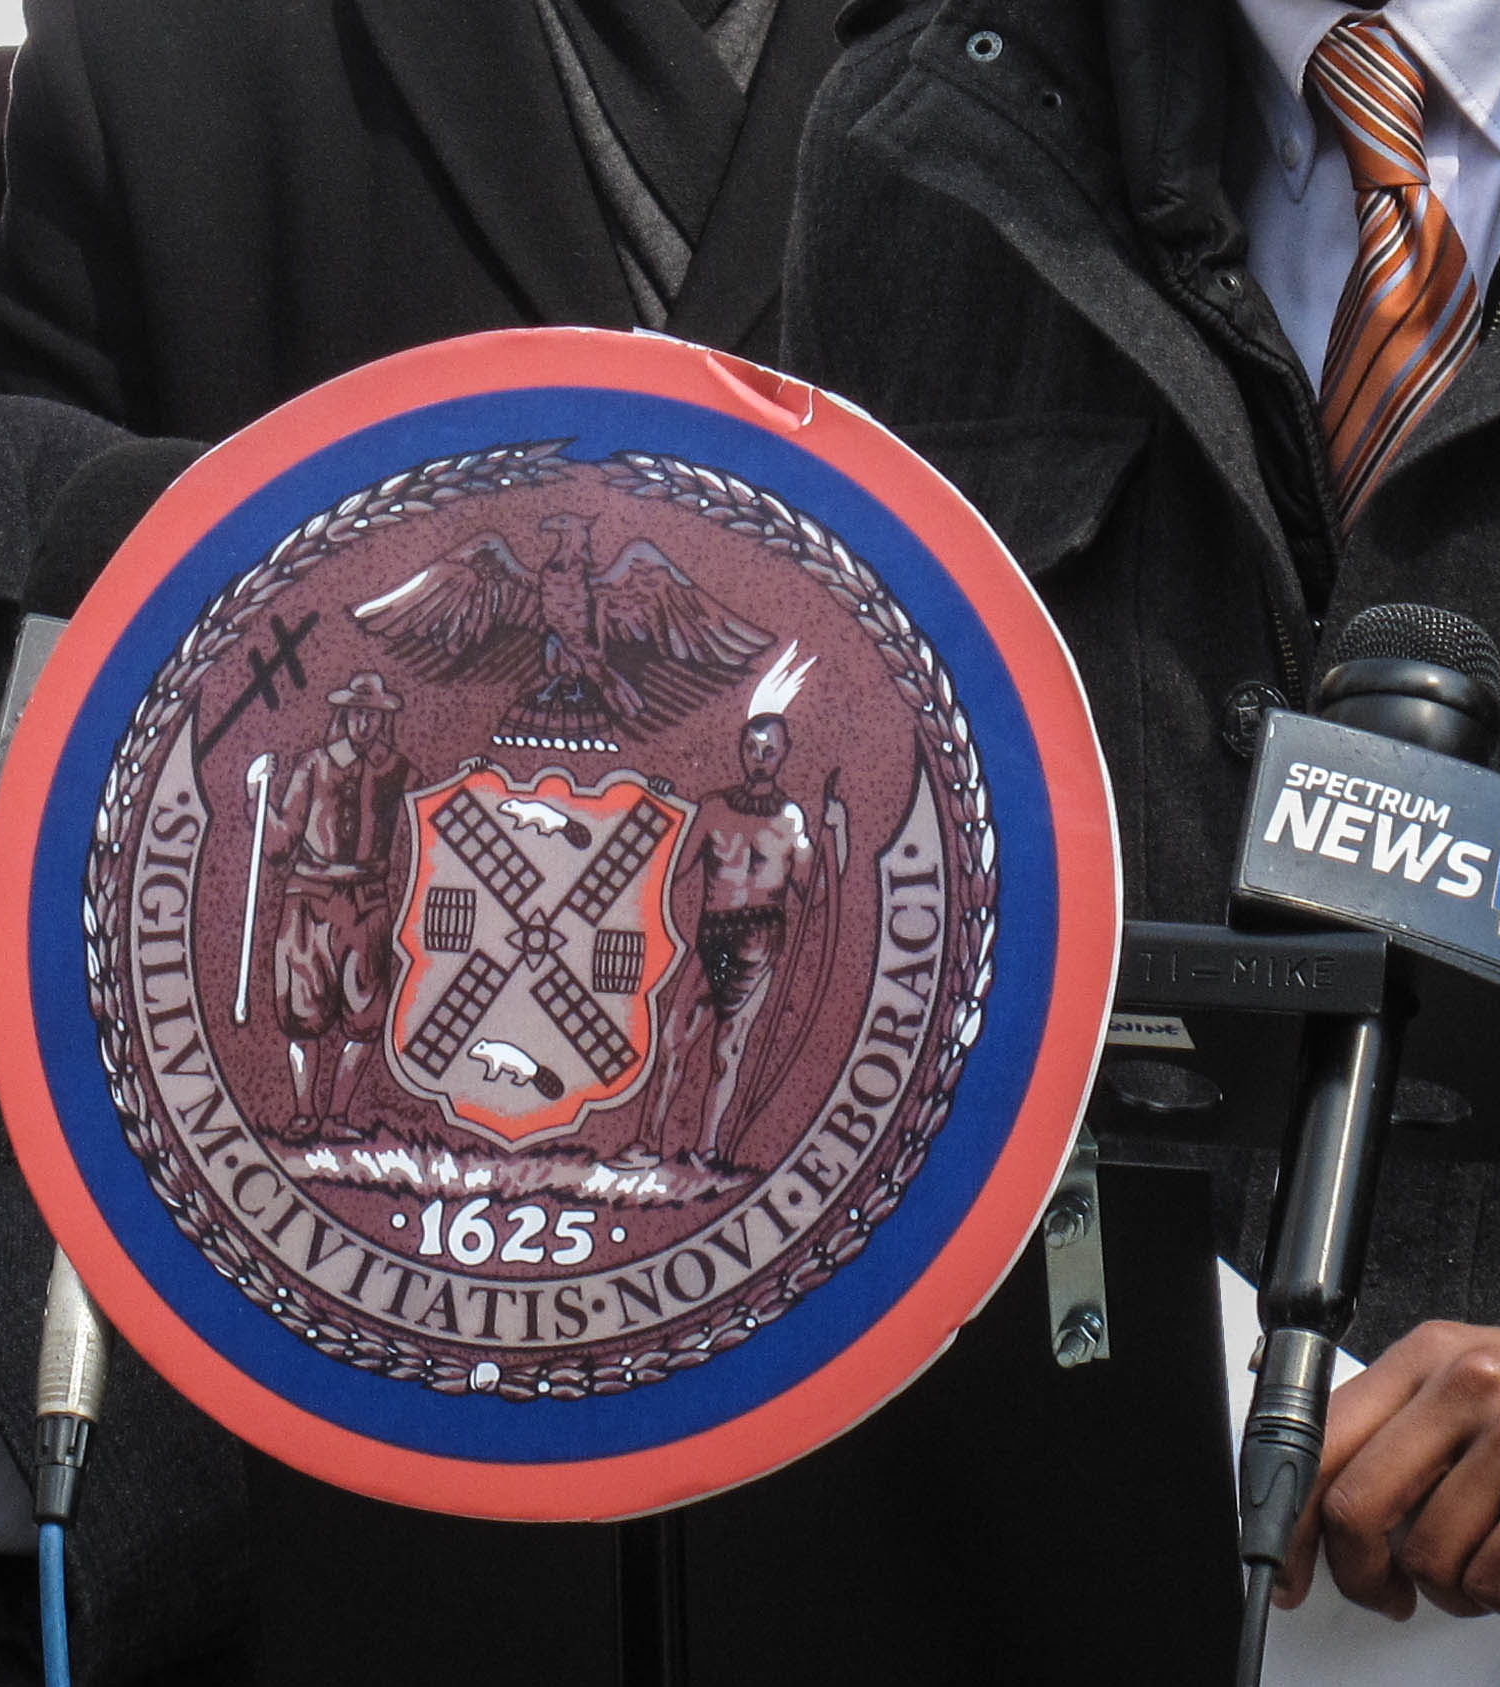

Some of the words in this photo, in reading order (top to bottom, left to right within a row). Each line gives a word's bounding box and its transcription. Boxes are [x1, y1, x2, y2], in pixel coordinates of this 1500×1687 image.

[1284, 761, 1452, 829] SPECTRUM
[1263, 786, 1493, 899] NEWS
[611, 1191, 802, 1329] NOVI
[787, 863, 941, 1205] EBORACI
[418, 1198, 597, 1266] 1625
